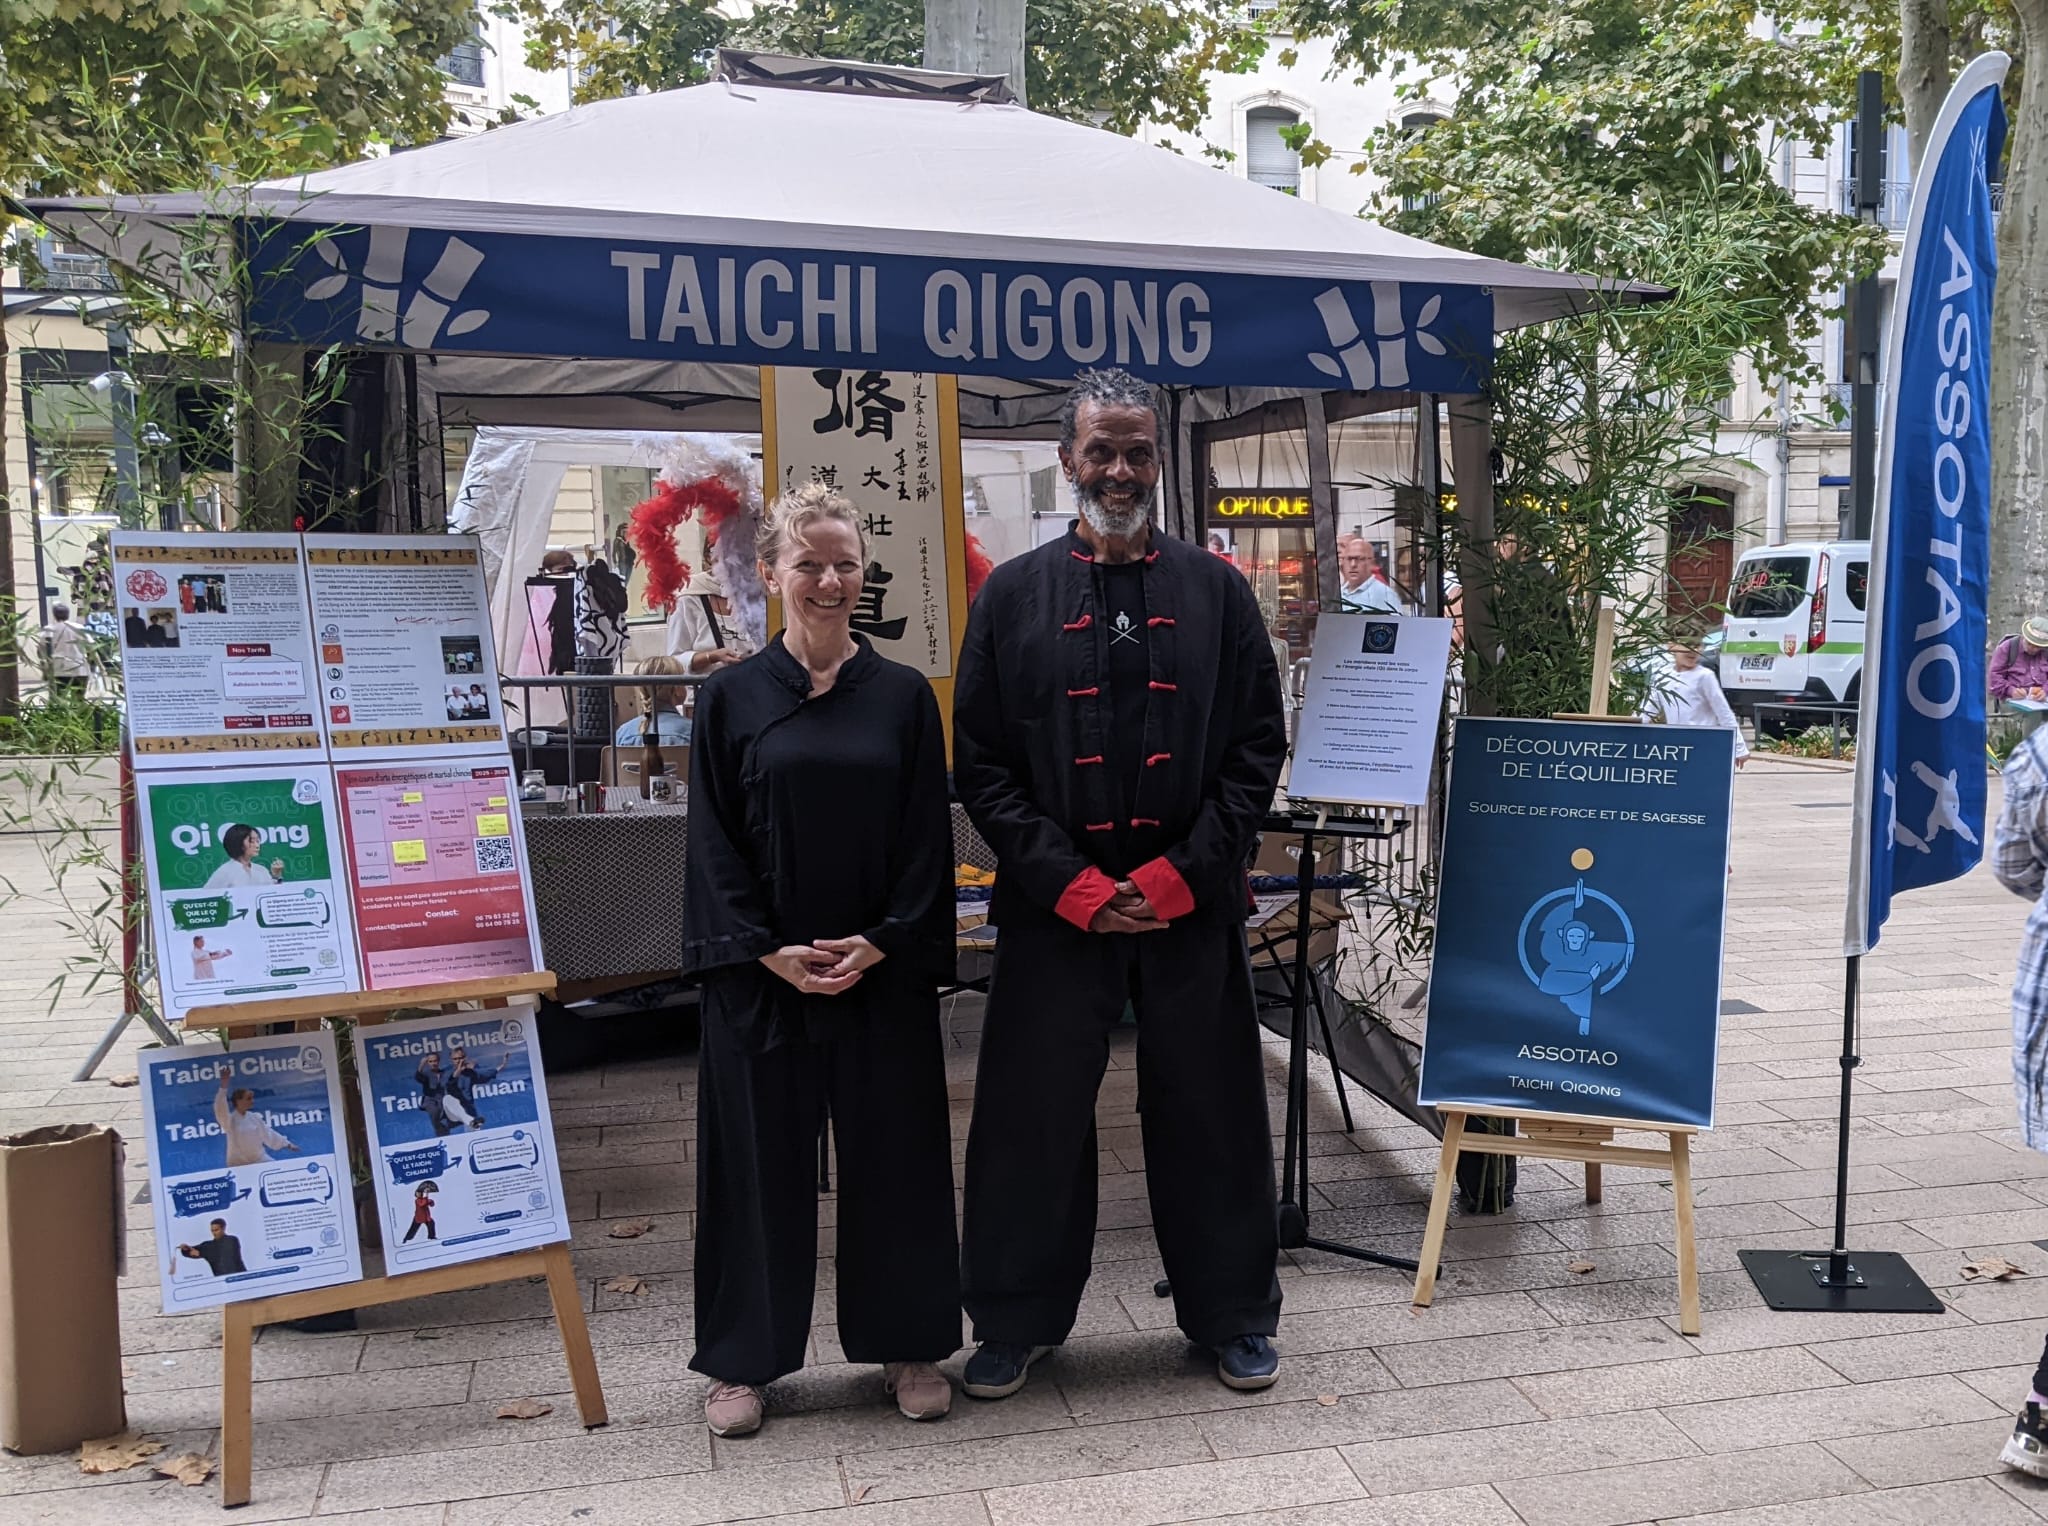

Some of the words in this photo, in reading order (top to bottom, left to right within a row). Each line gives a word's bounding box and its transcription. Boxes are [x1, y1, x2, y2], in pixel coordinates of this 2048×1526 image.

[611, 251, 877, 355] TAICHI
[924, 270, 1212, 368] QIGONG
[1906, 223, 1973, 720] ASSOTAO
[1218, 495, 1310, 519] OPTIQUE
[1486, 735, 1628, 759] DÉCOUVREZ
[1633, 744, 1694, 762] L'ART
[1502, 761, 1533, 779] DE
[1538, 761, 1678, 785] L'ÉQUILIBRE
[1529, 806, 1549, 816] DE
[1550, 807, 1597, 819] FORCE
[1599, 810, 1617, 820] ET
[1620, 811, 1639, 821] DE
[1642, 812, 1707, 825] SAGESSE
[171, 822, 211, 855] Qi
[182, 901, 219, 911] QU'EST-CE
[363, 903, 393, 911] scolaires
[374, 895, 393, 903] cours
[418, 892, 431, 900] pas
[185, 910, 200, 918] QUE
[209, 908, 218, 917] QI
[373, 1035, 443, 1060] Taichi
[446, 1031, 501, 1049] Chua
[1517, 1044, 1618, 1066] ASSOTAO
[159, 1058, 236, 1086] Taichi
[239, 1056, 300, 1076] Chua
[471, 1079, 526, 1100] huan
[1508, 1075, 1553, 1091] TAICHI
[393, 1153, 426, 1164] QU'EST-CE
[405, 1169, 429, 1177] CHUAN
[176, 1183, 213, 1196] QU'EST-CE
[214, 1181, 228, 1189] QUE
[189, 1201, 214, 1209] CHUAN
